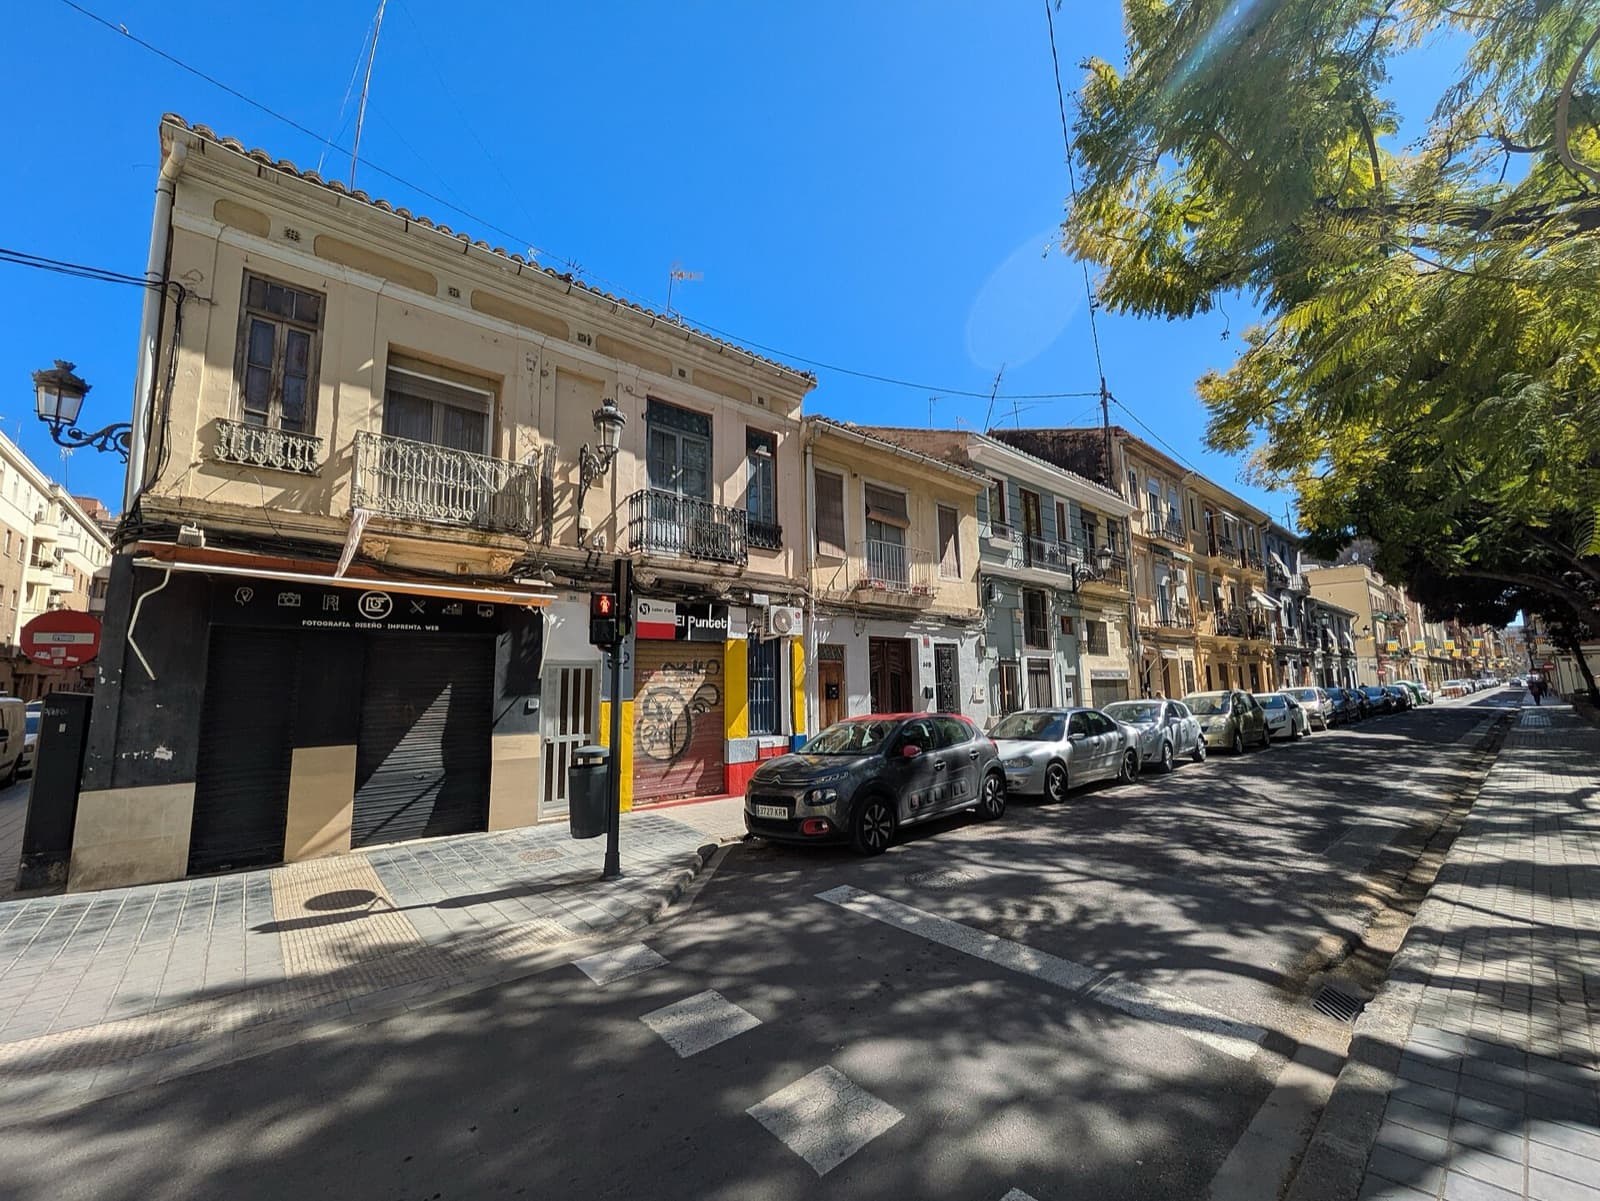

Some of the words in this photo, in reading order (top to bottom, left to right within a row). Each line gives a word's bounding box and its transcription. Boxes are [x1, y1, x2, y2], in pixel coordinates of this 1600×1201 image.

[355, 621, 382, 629] DISEÑO
[387, 623, 422, 631] IMPRENTA
[675, 615, 685, 627] El
[687, 603, 727, 641] Puntet
